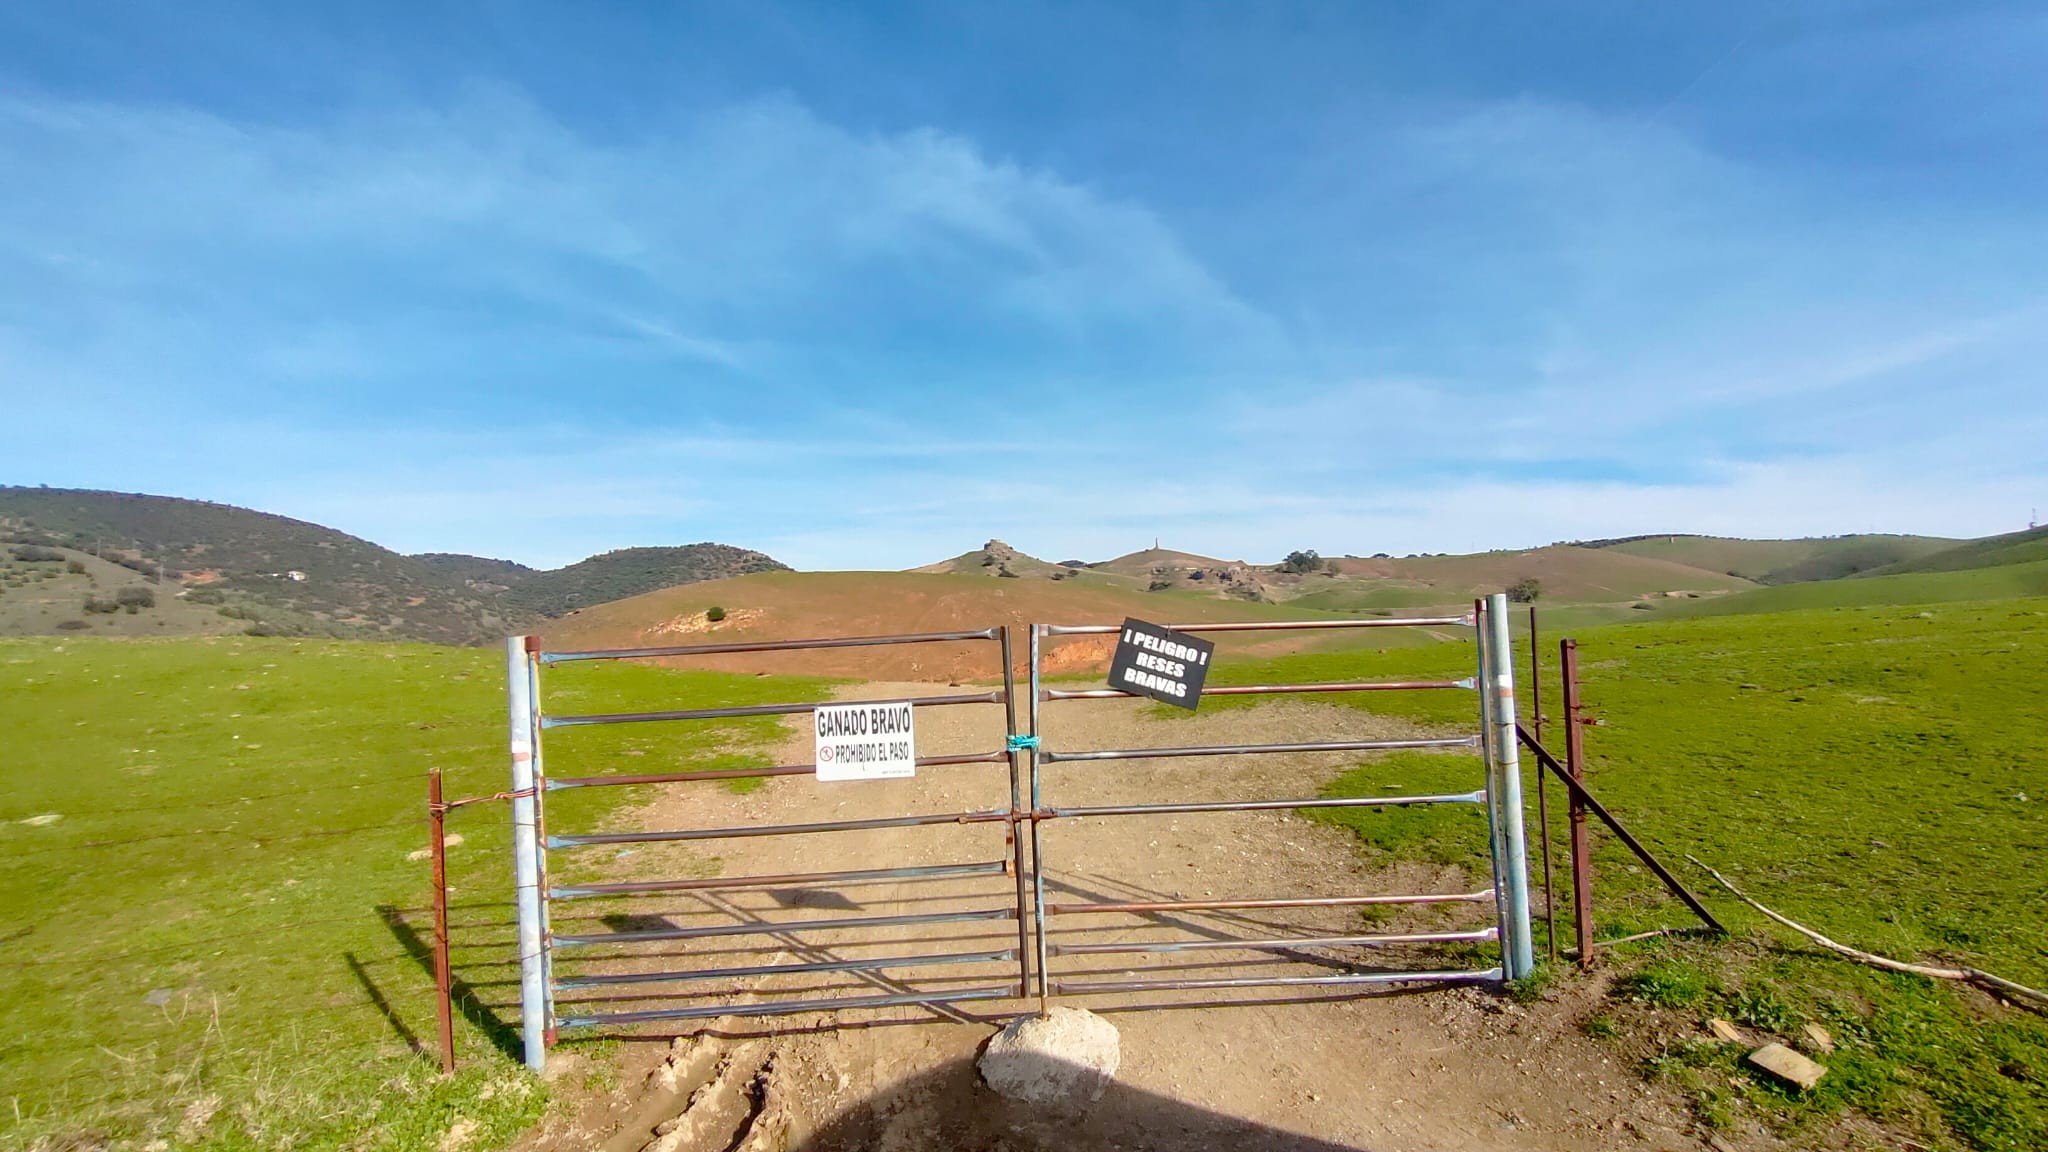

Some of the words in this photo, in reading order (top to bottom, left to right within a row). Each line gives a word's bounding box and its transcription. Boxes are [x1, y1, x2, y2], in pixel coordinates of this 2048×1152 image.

[1133, 631, 1198, 662] PELIGRO
[1135, 651, 1186, 678] RESES
[1124, 667, 1187, 698] BRAVAS
[818, 709, 867, 737] GANADO
[871, 706, 910, 734] BRAVO
[835, 743, 876, 763] PROHIBIDO
[879, 742, 888, 761] EL
[890, 741, 909, 760] PASO
